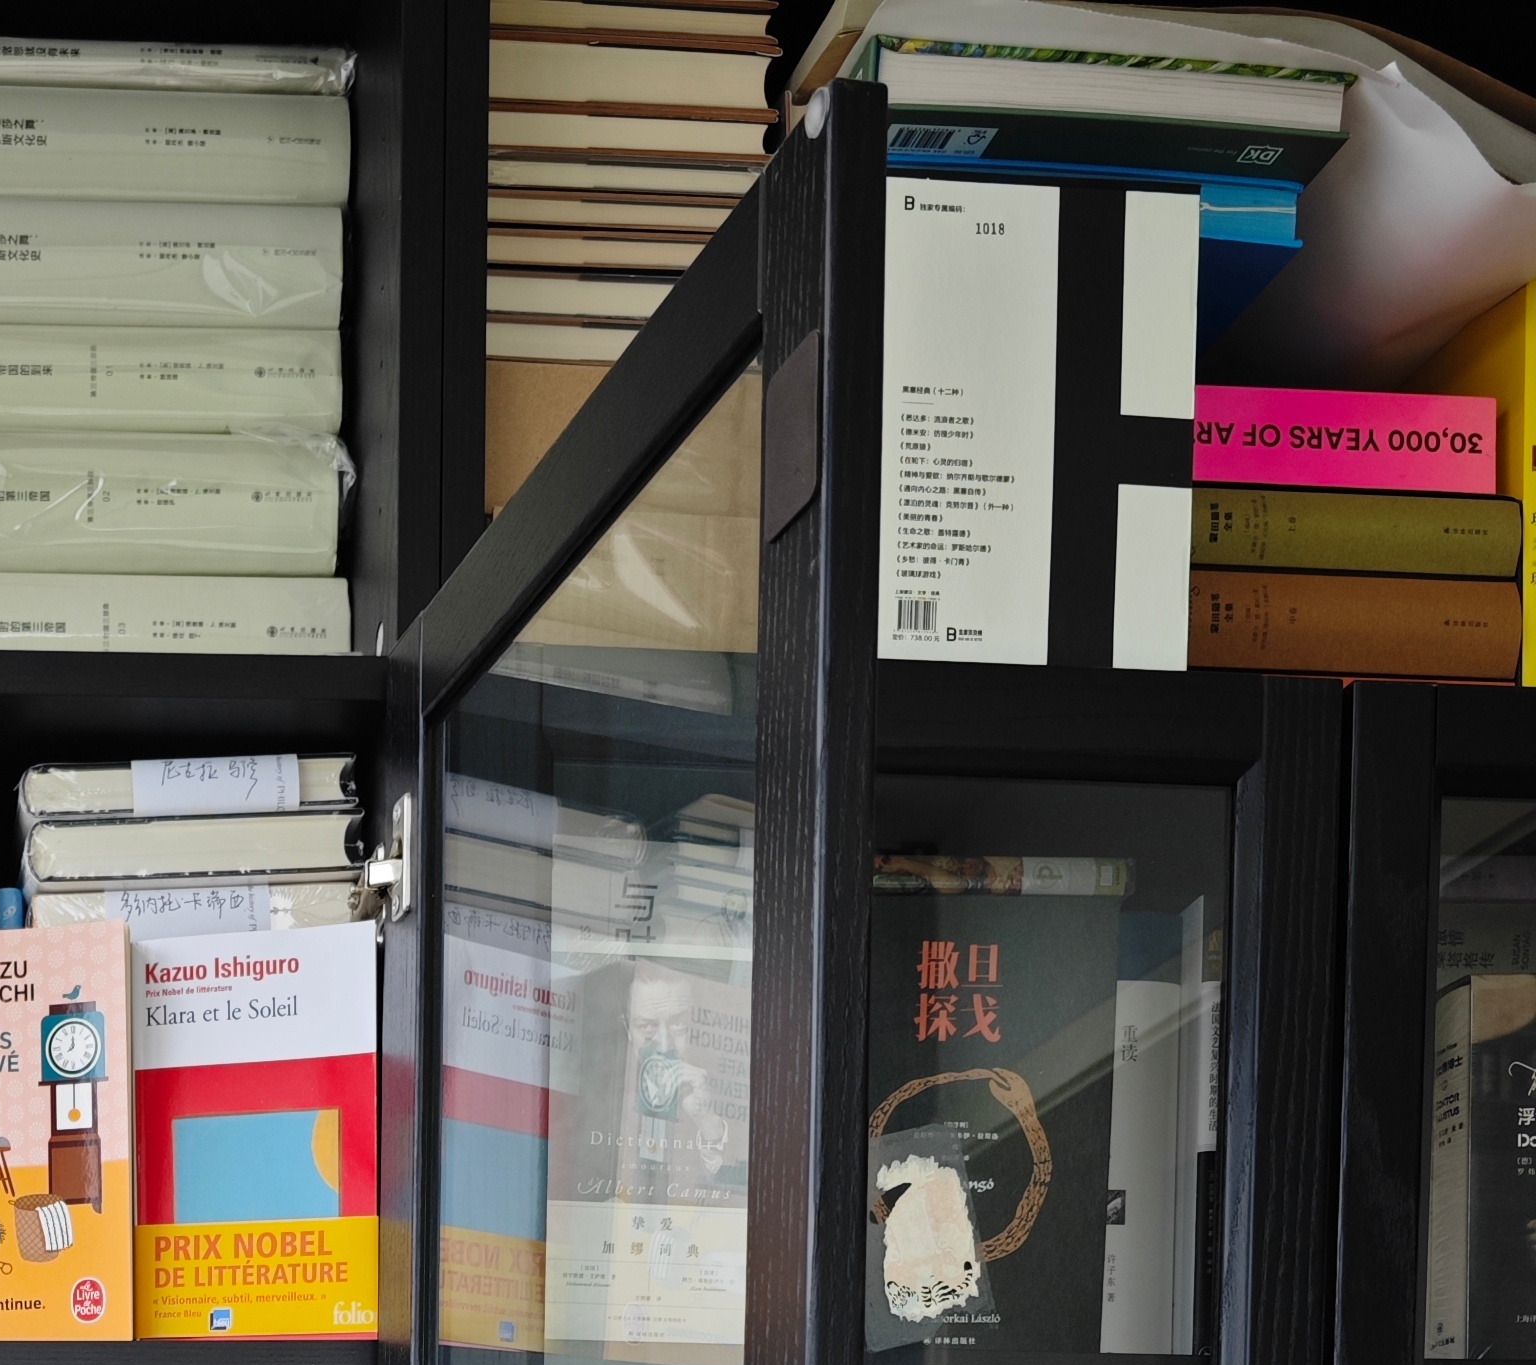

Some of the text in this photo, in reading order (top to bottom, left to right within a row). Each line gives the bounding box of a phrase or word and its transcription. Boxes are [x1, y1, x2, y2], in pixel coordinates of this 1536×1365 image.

[975, 222, 1006, 236] 1018
[145, 955, 300, 984] Kazuo Ishiguro
[915, 939, 1003, 990] 撒旦
[145, 996, 298, 1027] Klara et le Soleil
[913, 992, 1003, 1043] 探戈
[1120, 1024, 1138, 1063] 重读
[1208, 1000, 1221, 1132] 法国文艺复兴时期的生活
[631, 1216, 673, 1232] 挚爱
[154, 1230, 333, 1263] PRIX NOBEL
[601, 1240, 700, 1259] 加缪词典
[155, 1258, 349, 1289] DE LITTÉRATURE
[76, 1289, 101, 1301] Livre
[161, 1292, 318, 1305] Visionnaire, subtil, merveilleux.
[74, 1305, 102, 1317] Poche
[154, 1310, 202, 1319] France Bleu
[332, 1300, 375, 1325] folio
[970, 1311, 1001, 1324] László
